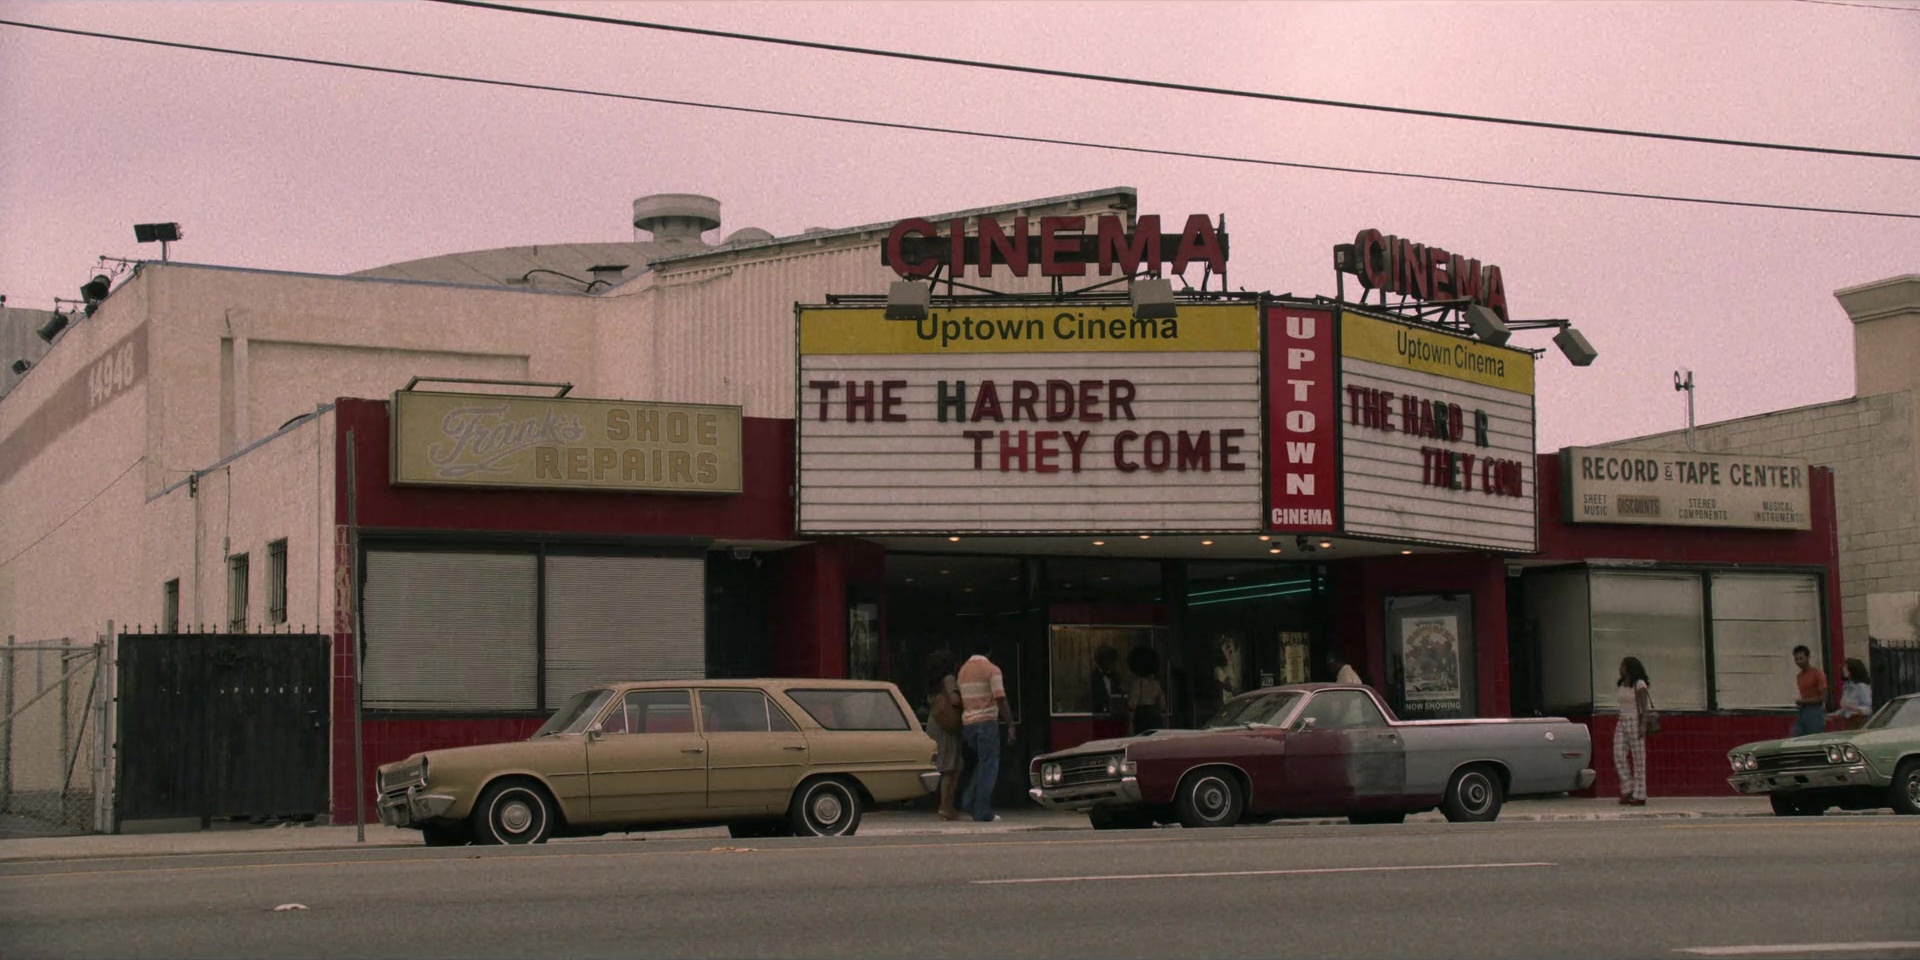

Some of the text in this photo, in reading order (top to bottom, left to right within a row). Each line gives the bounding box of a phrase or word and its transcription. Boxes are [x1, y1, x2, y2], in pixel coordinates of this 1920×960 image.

[887, 214, 1227, 278] CINEMA
[1354, 228, 1509, 321] CINEMA
[916, 313, 1178, 347] Uptown Cinema
[1397, 330, 1505, 378] Uptown Cinema
[809, 379, 1137, 423] THE HARDER
[1286, 317, 1315, 495] UPTOWN
[1347, 384, 1396, 432] THE
[428, 403, 717, 476] Frank's SHOE
[963, 428, 1245, 473] THEY COME
[535, 446, 718, 484] REPAIRS
[1421, 446, 1522, 498] THEY COM
[1582, 457, 1659, 482] RECORD
[1675, 461, 1720, 486] TAPE
[1730, 464, 1801, 488] CENTER
[1271, 508, 1333, 526] CINEMA
[1583, 494, 1607, 505] SHEET
[1584, 505, 1608, 517] MUSIC
[1617, 498, 1660, 515] DISCOUNTS
[1679, 509, 1728, 521] COMPONENTS
[1689, 498, 1716, 509] STEREO
[1763, 501, 1794, 512] MUSICAL
[1406, 701, 1461, 711] NOW SHOWING
